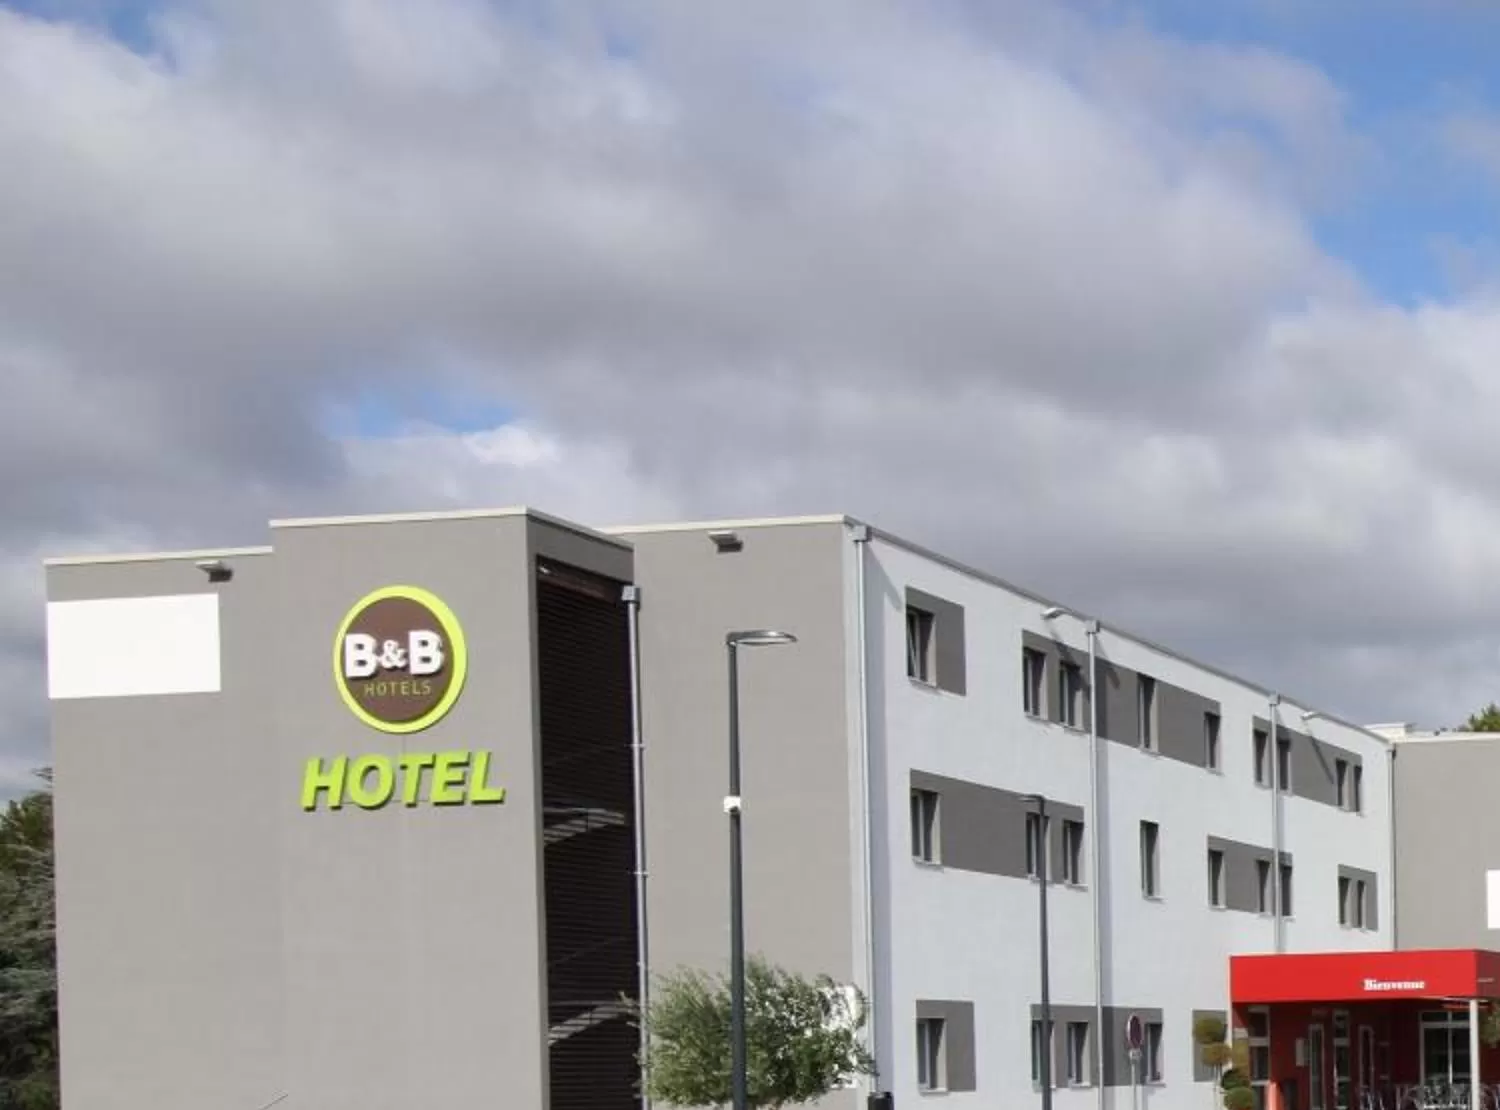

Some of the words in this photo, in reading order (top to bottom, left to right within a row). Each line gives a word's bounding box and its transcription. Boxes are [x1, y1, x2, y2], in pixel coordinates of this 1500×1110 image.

[345, 629, 445, 678] B&B
[362, 680, 432, 697] HOTELS
[301, 751, 505, 811] HOTEL
